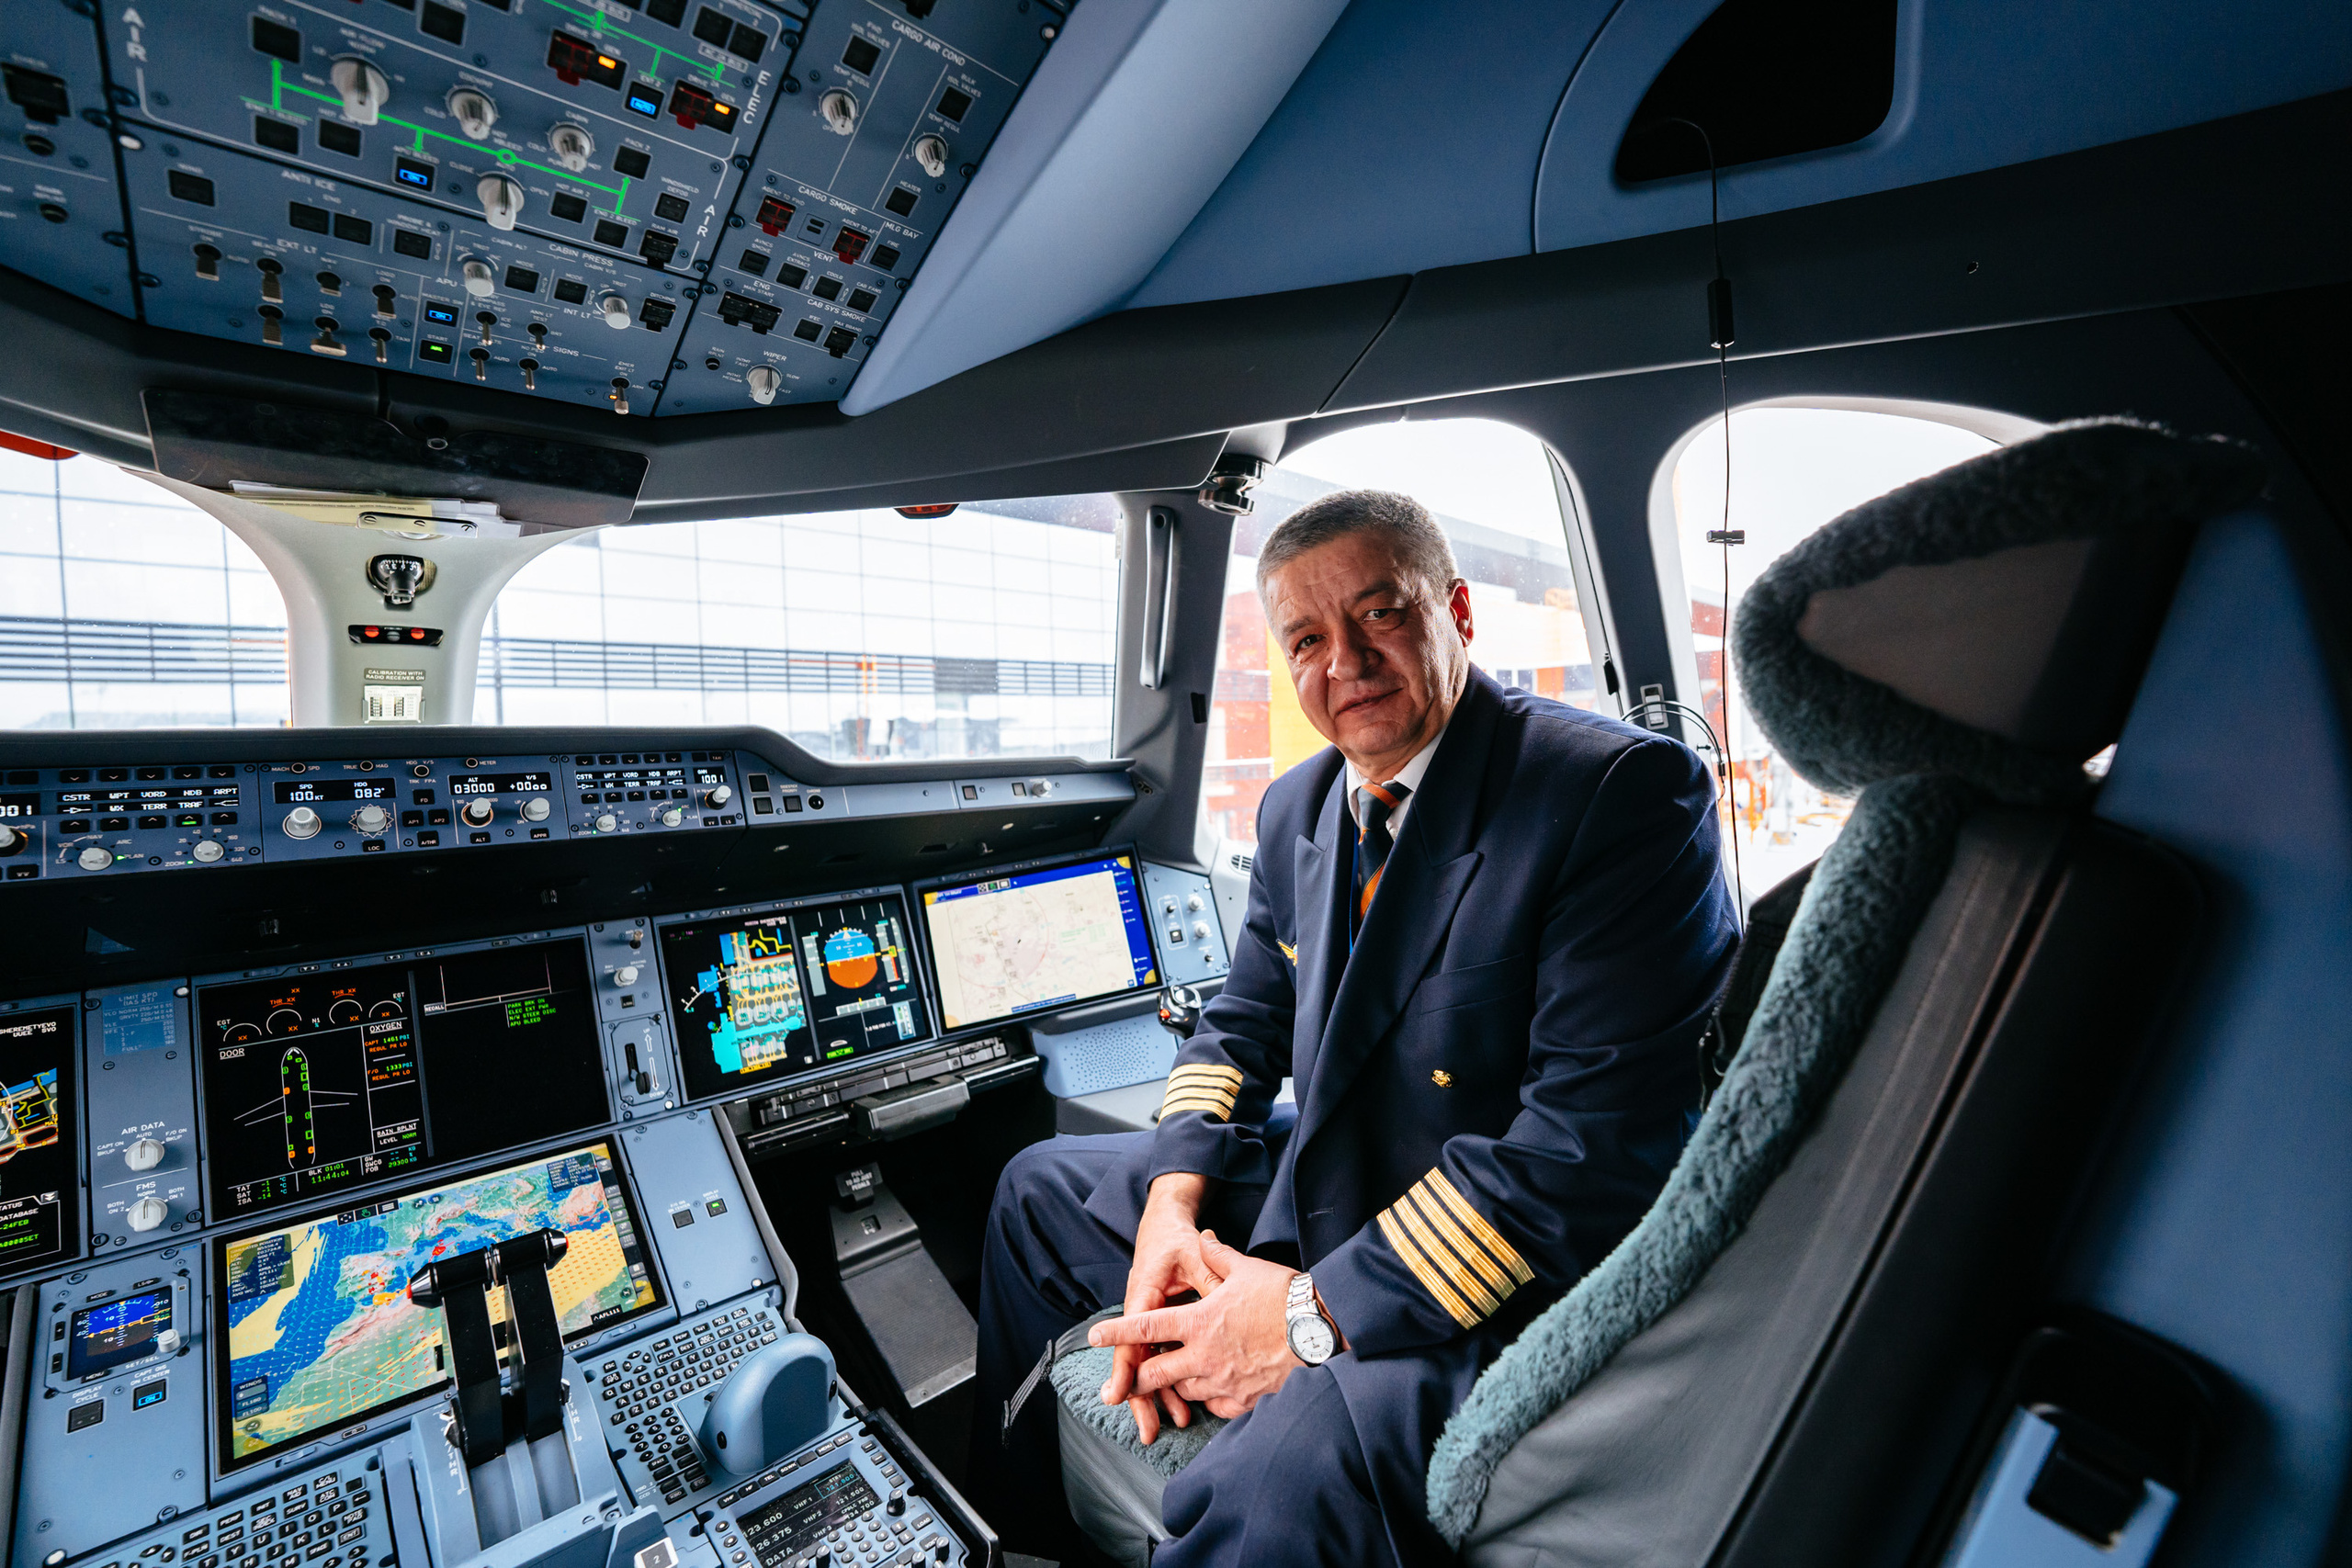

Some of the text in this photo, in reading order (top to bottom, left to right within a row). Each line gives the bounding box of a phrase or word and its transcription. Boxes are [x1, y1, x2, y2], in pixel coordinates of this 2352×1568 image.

[891, 20, 966, 66] CARGO AIR COND
[742, 70, 771, 124] ELEC
[282, 170, 335, 191] ANTI ICE
[900, 181, 922, 192] HEATER
[798, 186, 858, 215] CARGO SMOKE
[697, 205, 715, 237] AIR
[842, 218, 860, 228] AGENT
[868, 228, 878, 236] AFT
[885, 222, 919, 239] MLG BAY
[277, 239, 318, 254] EXT LT
[752, 243, 772, 254] SMOKE
[549, 244, 613, 266] CABIN PRESS
[813, 251, 834, 263] VENT
[787, 257, 810, 267] EXTRACT
[435, 276, 458, 288] APU
[753, 281, 771, 291] ENG
[650, 292, 676, 302] DITCHING
[743, 285, 775, 298] MAN START
[564, 308, 591, 320] INT LT
[808, 299, 866, 322] CAB SYS SMOKE
[844, 323, 863, 332] BBAND
[553, 346, 579, 356] SIGNS
[763, 351, 787, 361] WIPER
[702, 774, 723, 784] 1001
[455, 783, 494, 794] 03000
[290, 791, 313, 802] 100
[424, 1004, 445, 1012] RECALL
[0, 1021, 56, 1034] SHEREMETYEVO
[369, 1021, 402, 1032] OXYGEN
[220, 1048, 244, 1058] DOOR
[121, 1122, 165, 1135] AIR DATA
[377, 1123, 417, 1137] RAIN RPLNT
[379, 1137, 398, 1145] LEVEL
[388, 1158, 409, 1168] 29300
[309, 1163, 345, 1177] BLK 01:01
[851, 1169, 864, 1178] PULL
[311, 1169, 349, 1184] 11:44:04
[136, 1181, 156, 1190] FMS
[852, 1179, 871, 1190] PEDALS
[107, 1201, 124, 1209] BOTH
[91, 1292, 107, 1300] MODE
[599, 1308, 621, 1319] AFL111
[125, 1356, 159, 1369] SET/SEL
[134, 1371, 152, 1379] CAPT
[72, 1385, 103, 1398] DISPLAY
[818, 1443, 832, 1452] MENU
[781, 1462, 797, 1472] SQWK
[723, 1494, 735, 1503] VHF
[286, 1503, 306, 1515] SURV
[220, 1513, 242, 1527] PERF
[743, 1512, 783, 1538] 123.600
[917, 1517, 931, 1528] LOAD
[752, 1527, 792, 1553] 126.375
[653, 1555, 660, 1563] 2
[766, 1547, 794, 1566] DATA
